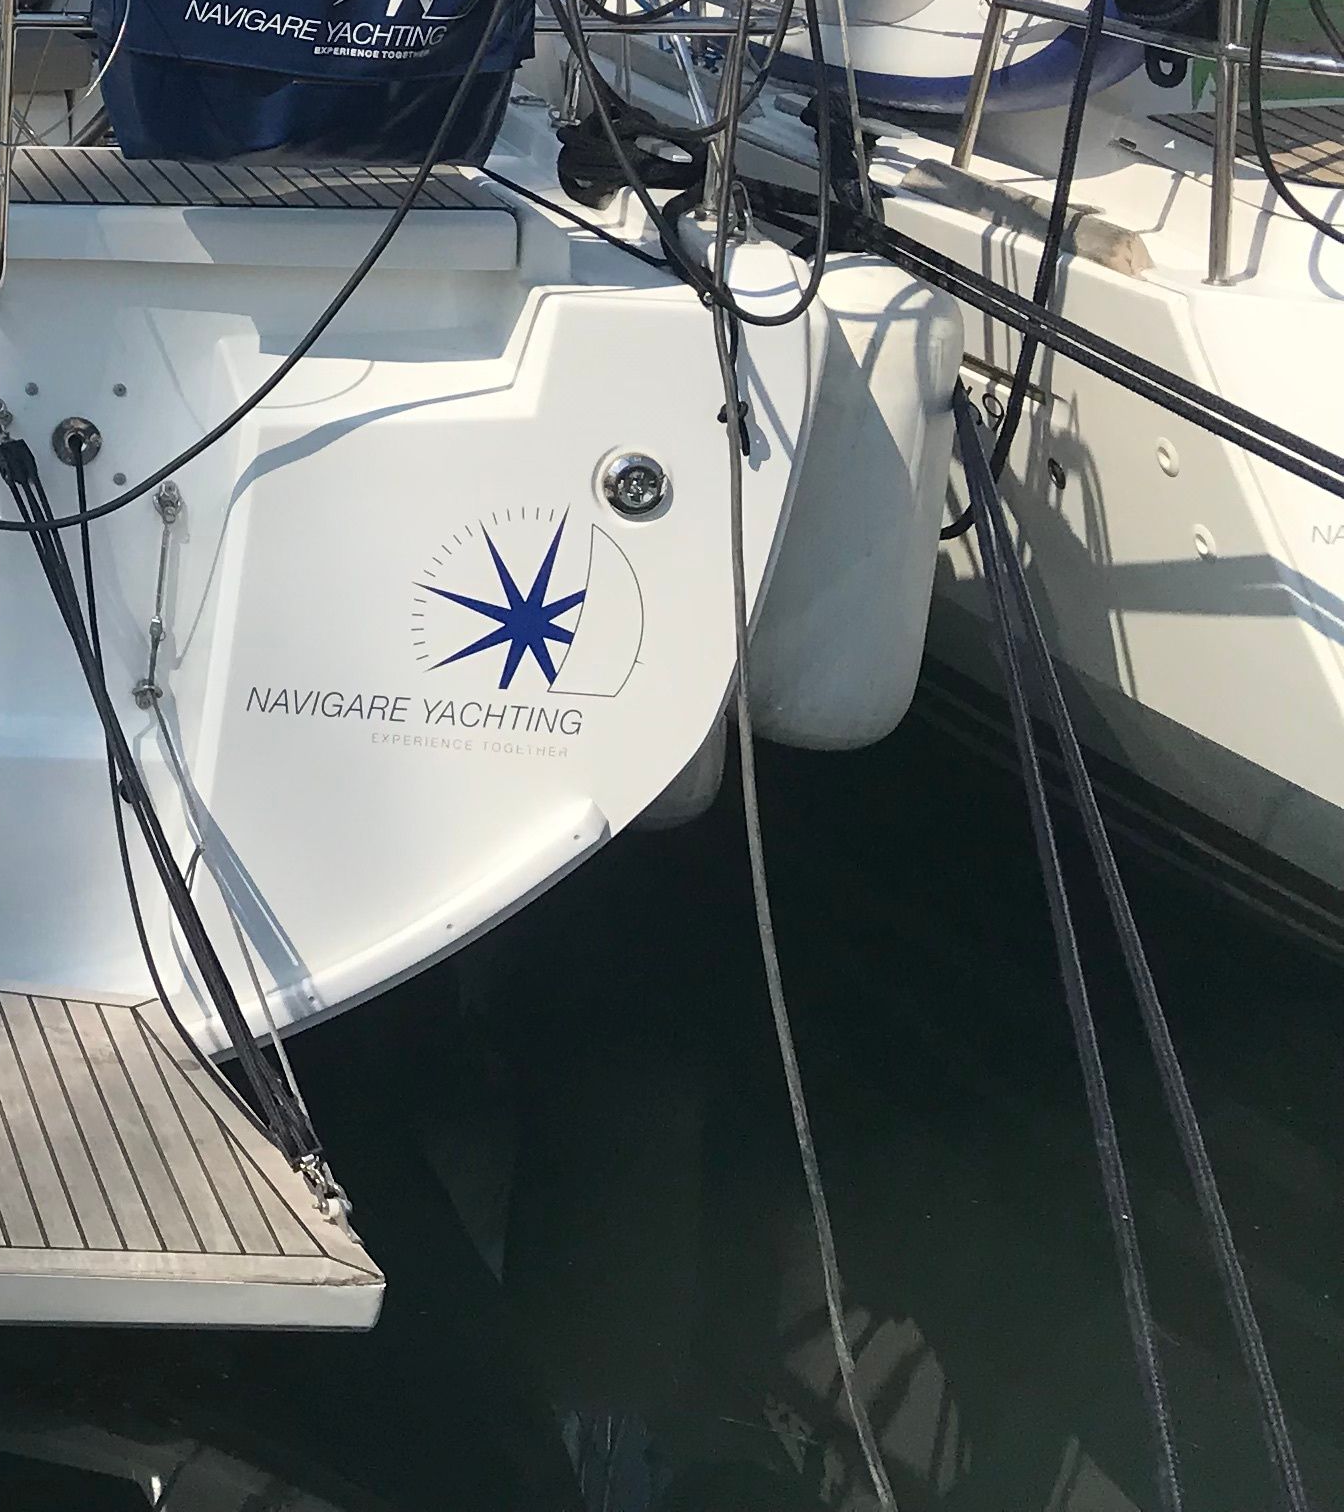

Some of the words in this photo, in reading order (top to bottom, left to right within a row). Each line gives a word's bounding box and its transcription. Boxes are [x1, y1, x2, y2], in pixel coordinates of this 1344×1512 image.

[184, 0, 321, 41] NAVIGARE
[326, 20, 448, 48] YACHTING
[313, 46, 380, 59] EXPERIENCE
[246, 686, 411, 723] NAVIGARE
[422, 698, 583, 736] YACHTING
[371, 733, 473, 752] EXPERIENCE
[482, 741, 569, 758] TOGETHER
